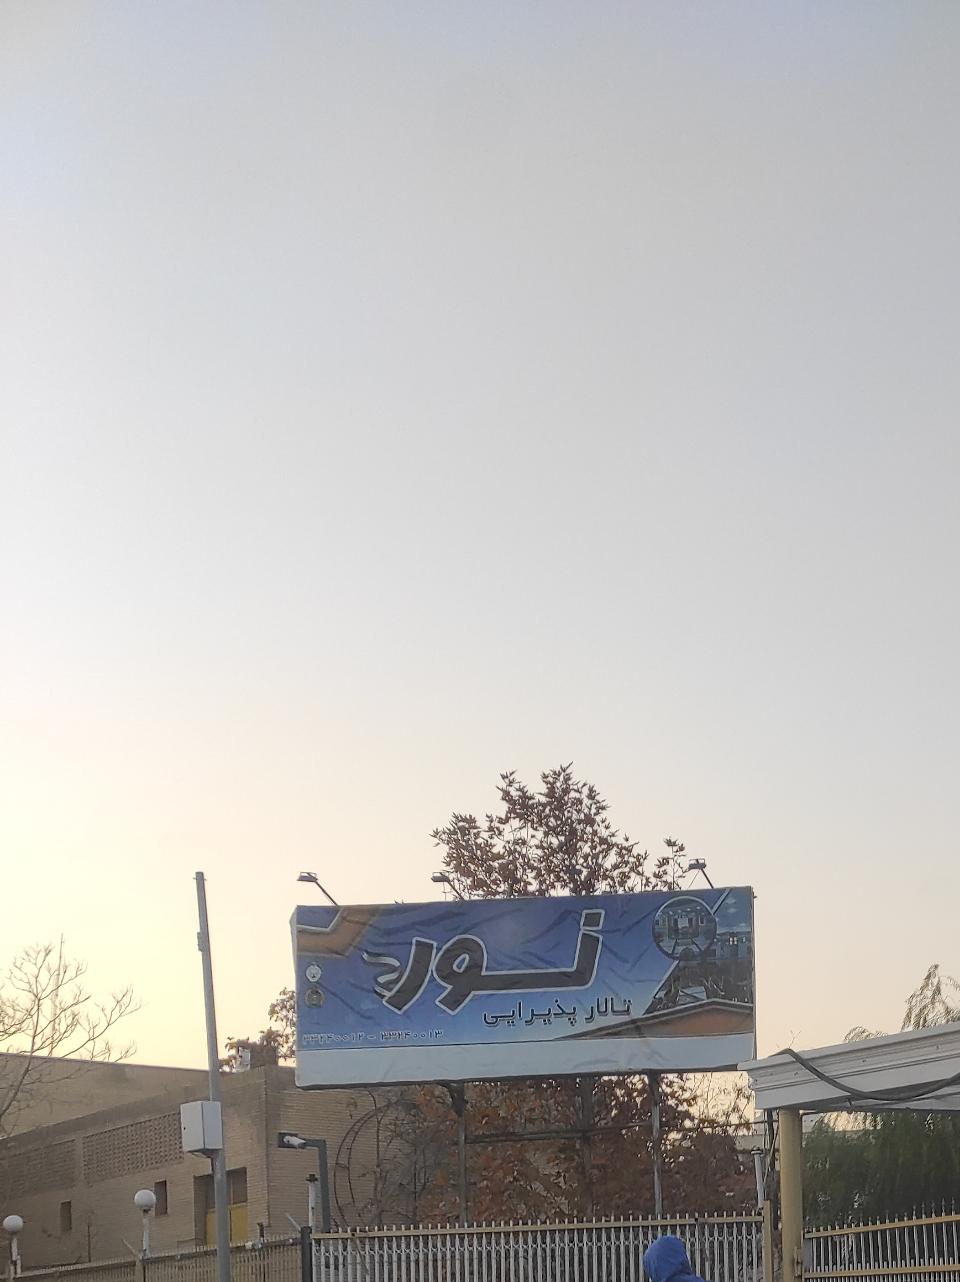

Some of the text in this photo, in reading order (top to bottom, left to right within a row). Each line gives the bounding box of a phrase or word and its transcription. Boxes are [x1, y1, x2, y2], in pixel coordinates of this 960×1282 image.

[362, 909, 606, 1015] نور
[483, 996, 633, 1028] تالار پذیرایی
